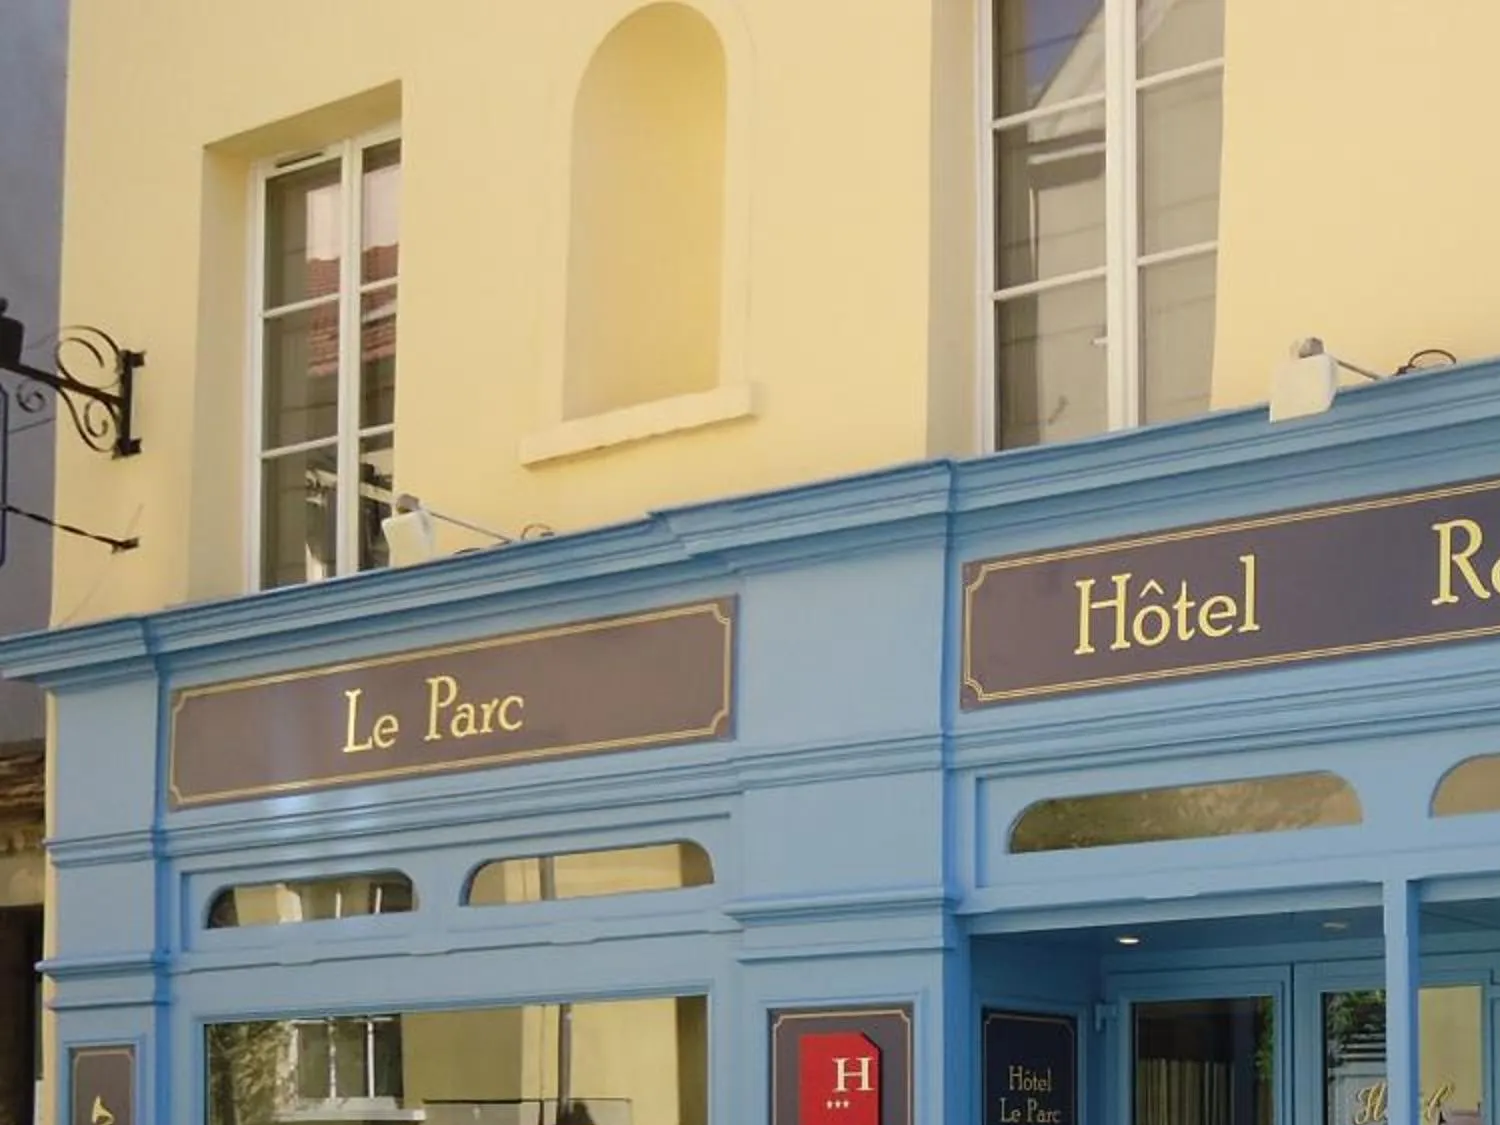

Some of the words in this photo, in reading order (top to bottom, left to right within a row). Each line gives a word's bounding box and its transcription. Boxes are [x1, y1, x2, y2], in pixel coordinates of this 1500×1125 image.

[1071, 554, 1260, 656] Hôtel
[343, 688, 398, 753] Le
[423, 675, 524, 741] Parc
[832, 1057, 875, 1092] H
[1008, 1065, 1052, 1092] Hôtel
[1000, 1097, 1021, 1123] Le
[1027, 1097, 1061, 1123] Parc
